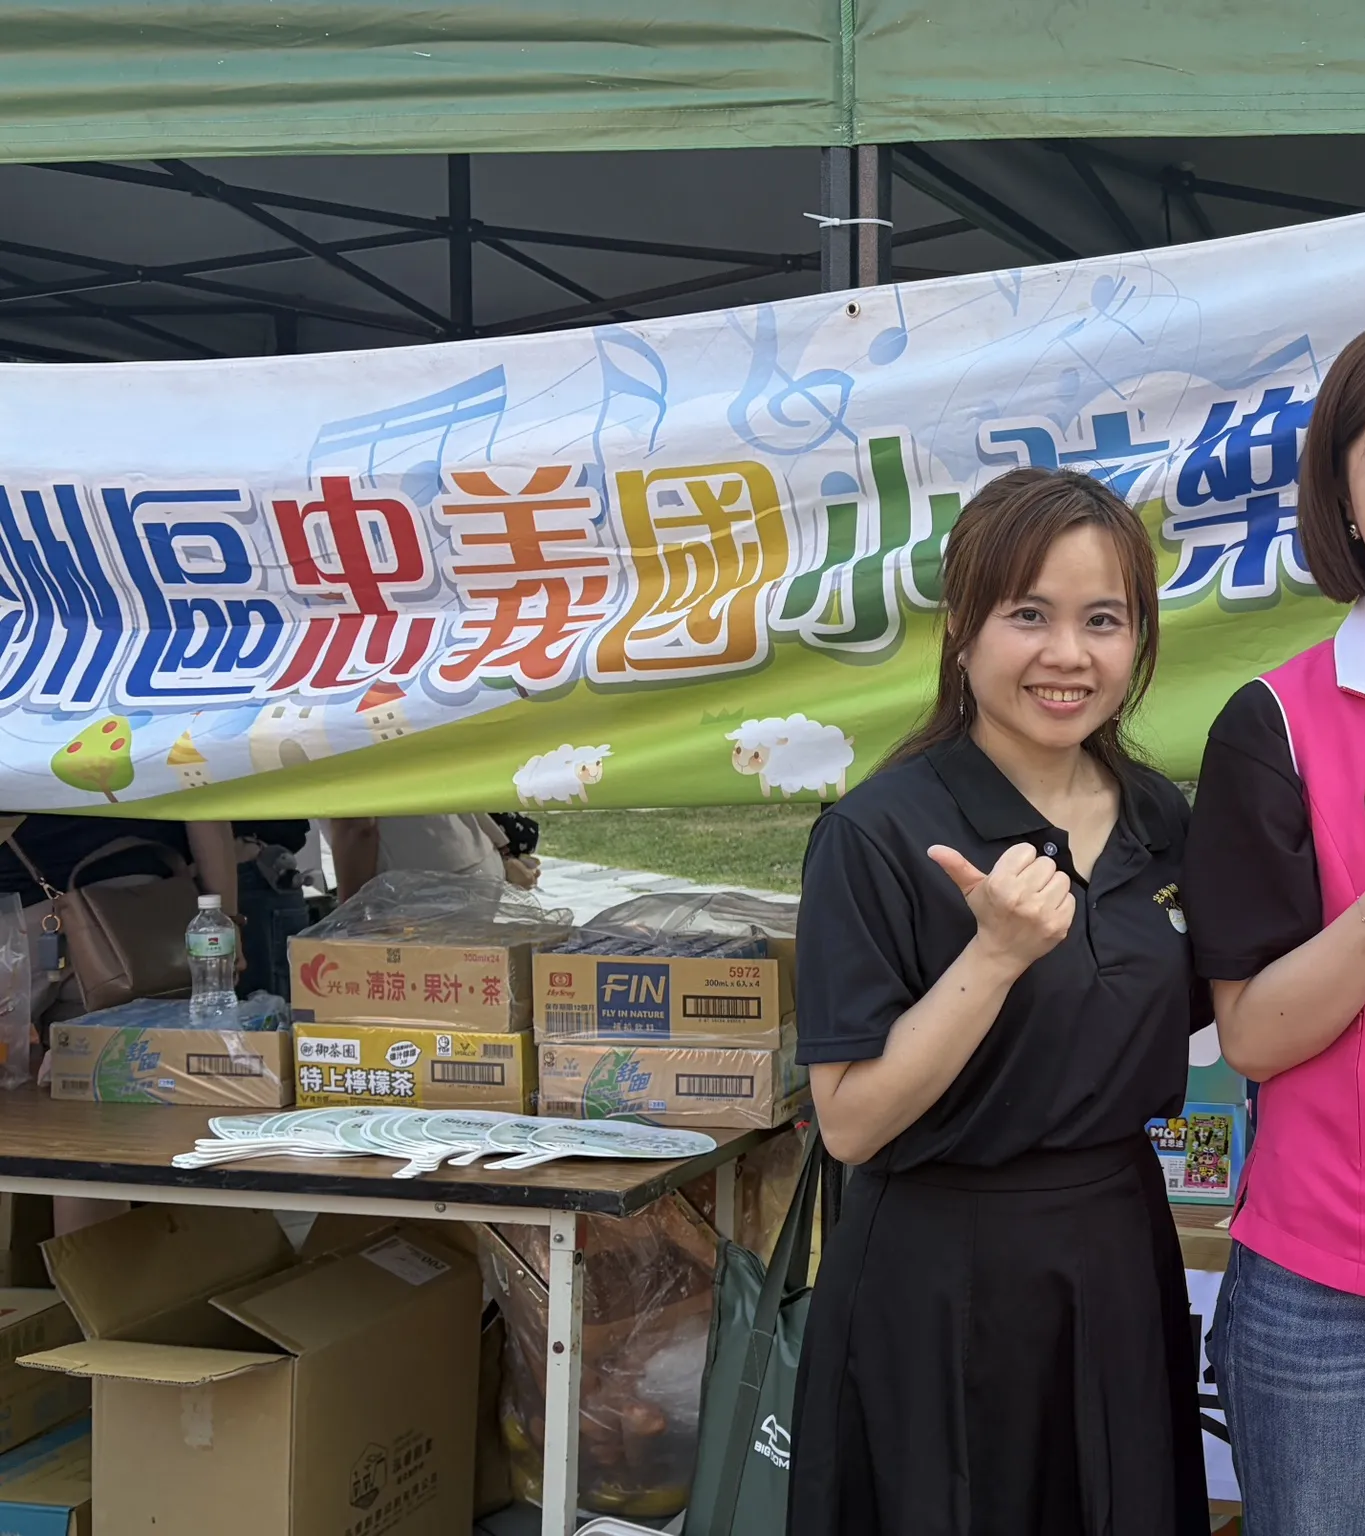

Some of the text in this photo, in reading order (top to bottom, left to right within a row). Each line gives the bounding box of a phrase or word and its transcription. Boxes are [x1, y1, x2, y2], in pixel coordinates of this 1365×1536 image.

[728, 966, 761, 978] 5972
[326, 979, 362, 996] 光泉
[600, 973, 667, 1004] FIN
[601, 1009, 665, 1020] FLY IN NATURE
[315, 1043, 356, 1059] 御茶園
[299, 1065, 415, 1097] 特上檸檬茶
[613, 1060, 653, 1093] 舒跑
